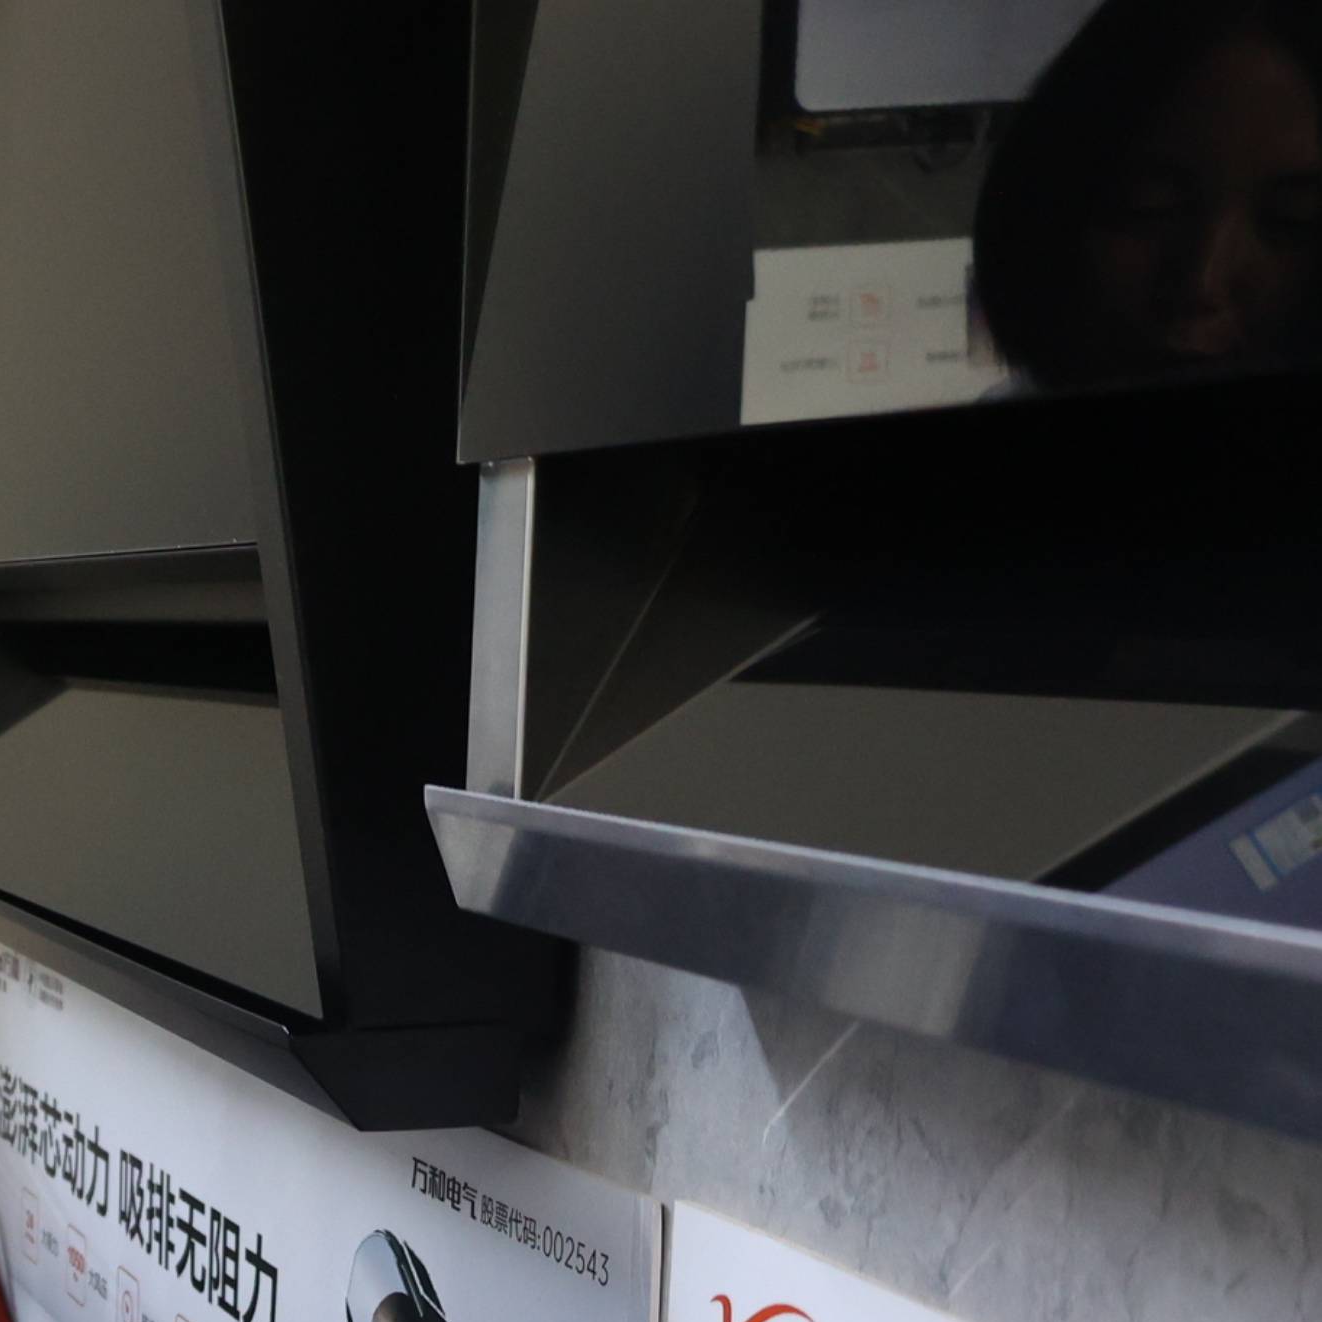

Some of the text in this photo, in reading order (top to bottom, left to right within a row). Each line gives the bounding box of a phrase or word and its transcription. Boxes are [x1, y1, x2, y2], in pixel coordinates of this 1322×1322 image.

[411, 1156, 610, 1287] 万和电气 股票代码:002543
